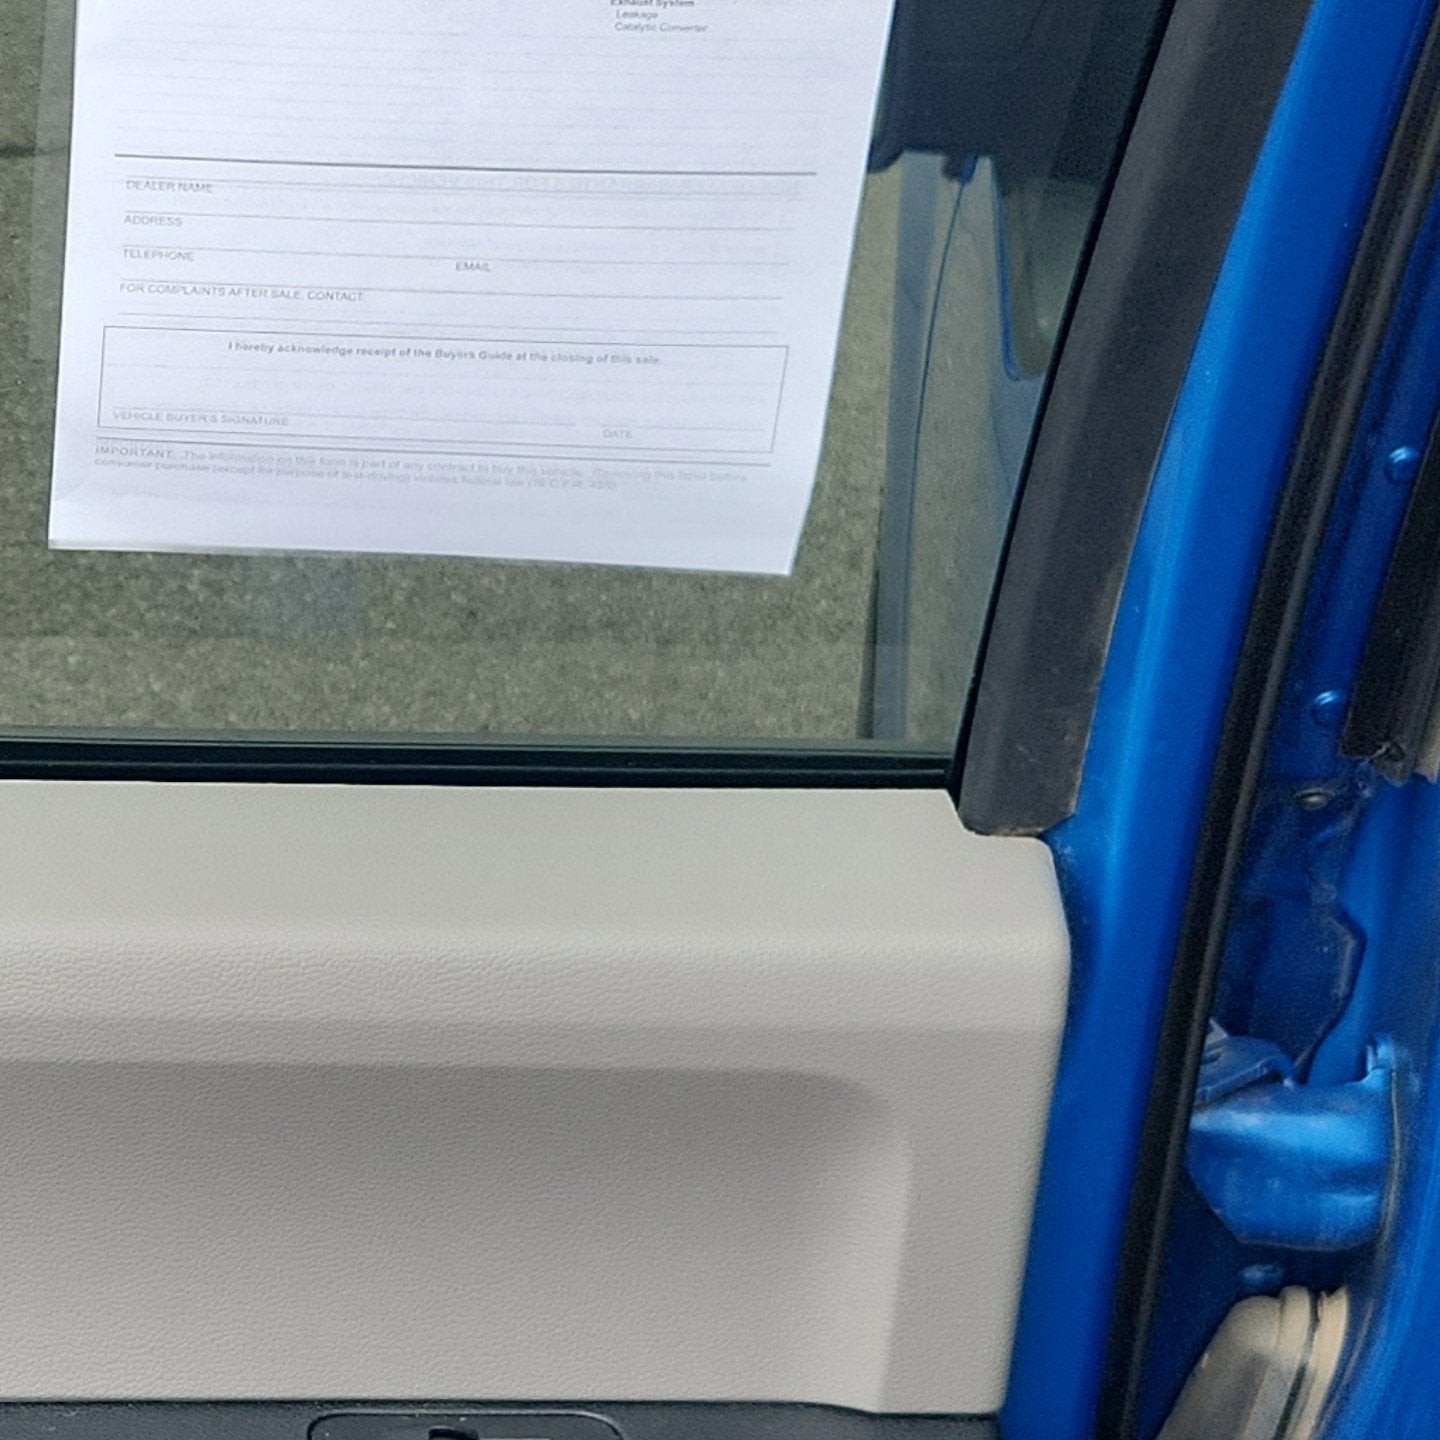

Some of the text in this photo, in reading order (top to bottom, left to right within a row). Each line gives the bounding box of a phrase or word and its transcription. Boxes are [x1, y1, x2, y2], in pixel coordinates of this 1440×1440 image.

[615, 9, 659, 21] Leakage
[614, 21, 708, 33] Catalytic Converter
[126, 179, 213, 193] DEALER NAME
[124, 214, 183, 227] ADDRESS
[122, 248, 194, 261] TELEPHONE
[454, 261, 491, 272] EMAIL
[119, 282, 145, 293] FOR
[146, 283, 226, 296] COMPLAINTS
[227, 286, 268, 298] AFTER
[306, 289, 363, 302] CONTACT
[227, 341, 232, 350] I
[234, 341, 275, 353] hereby
[276, 343, 353, 356] acknowledge
[355, 345, 397, 357] receipt
[398, 347, 411, 356] of
[412, 347, 432, 357] the
[433, 348, 476, 360] Buyers
[477, 349, 513, 361] Guide
[515, 351, 527, 361] at
[528, 351, 548, 362] the
[549, 352, 594, 365] closing
[595, 353, 609, 363] of
[609, 353, 632, 364] this
[112, 410, 162, 421] VEHICLE
[220, 414, 289, 426] SIGNATURE
[602, 428, 632, 439] DATE
